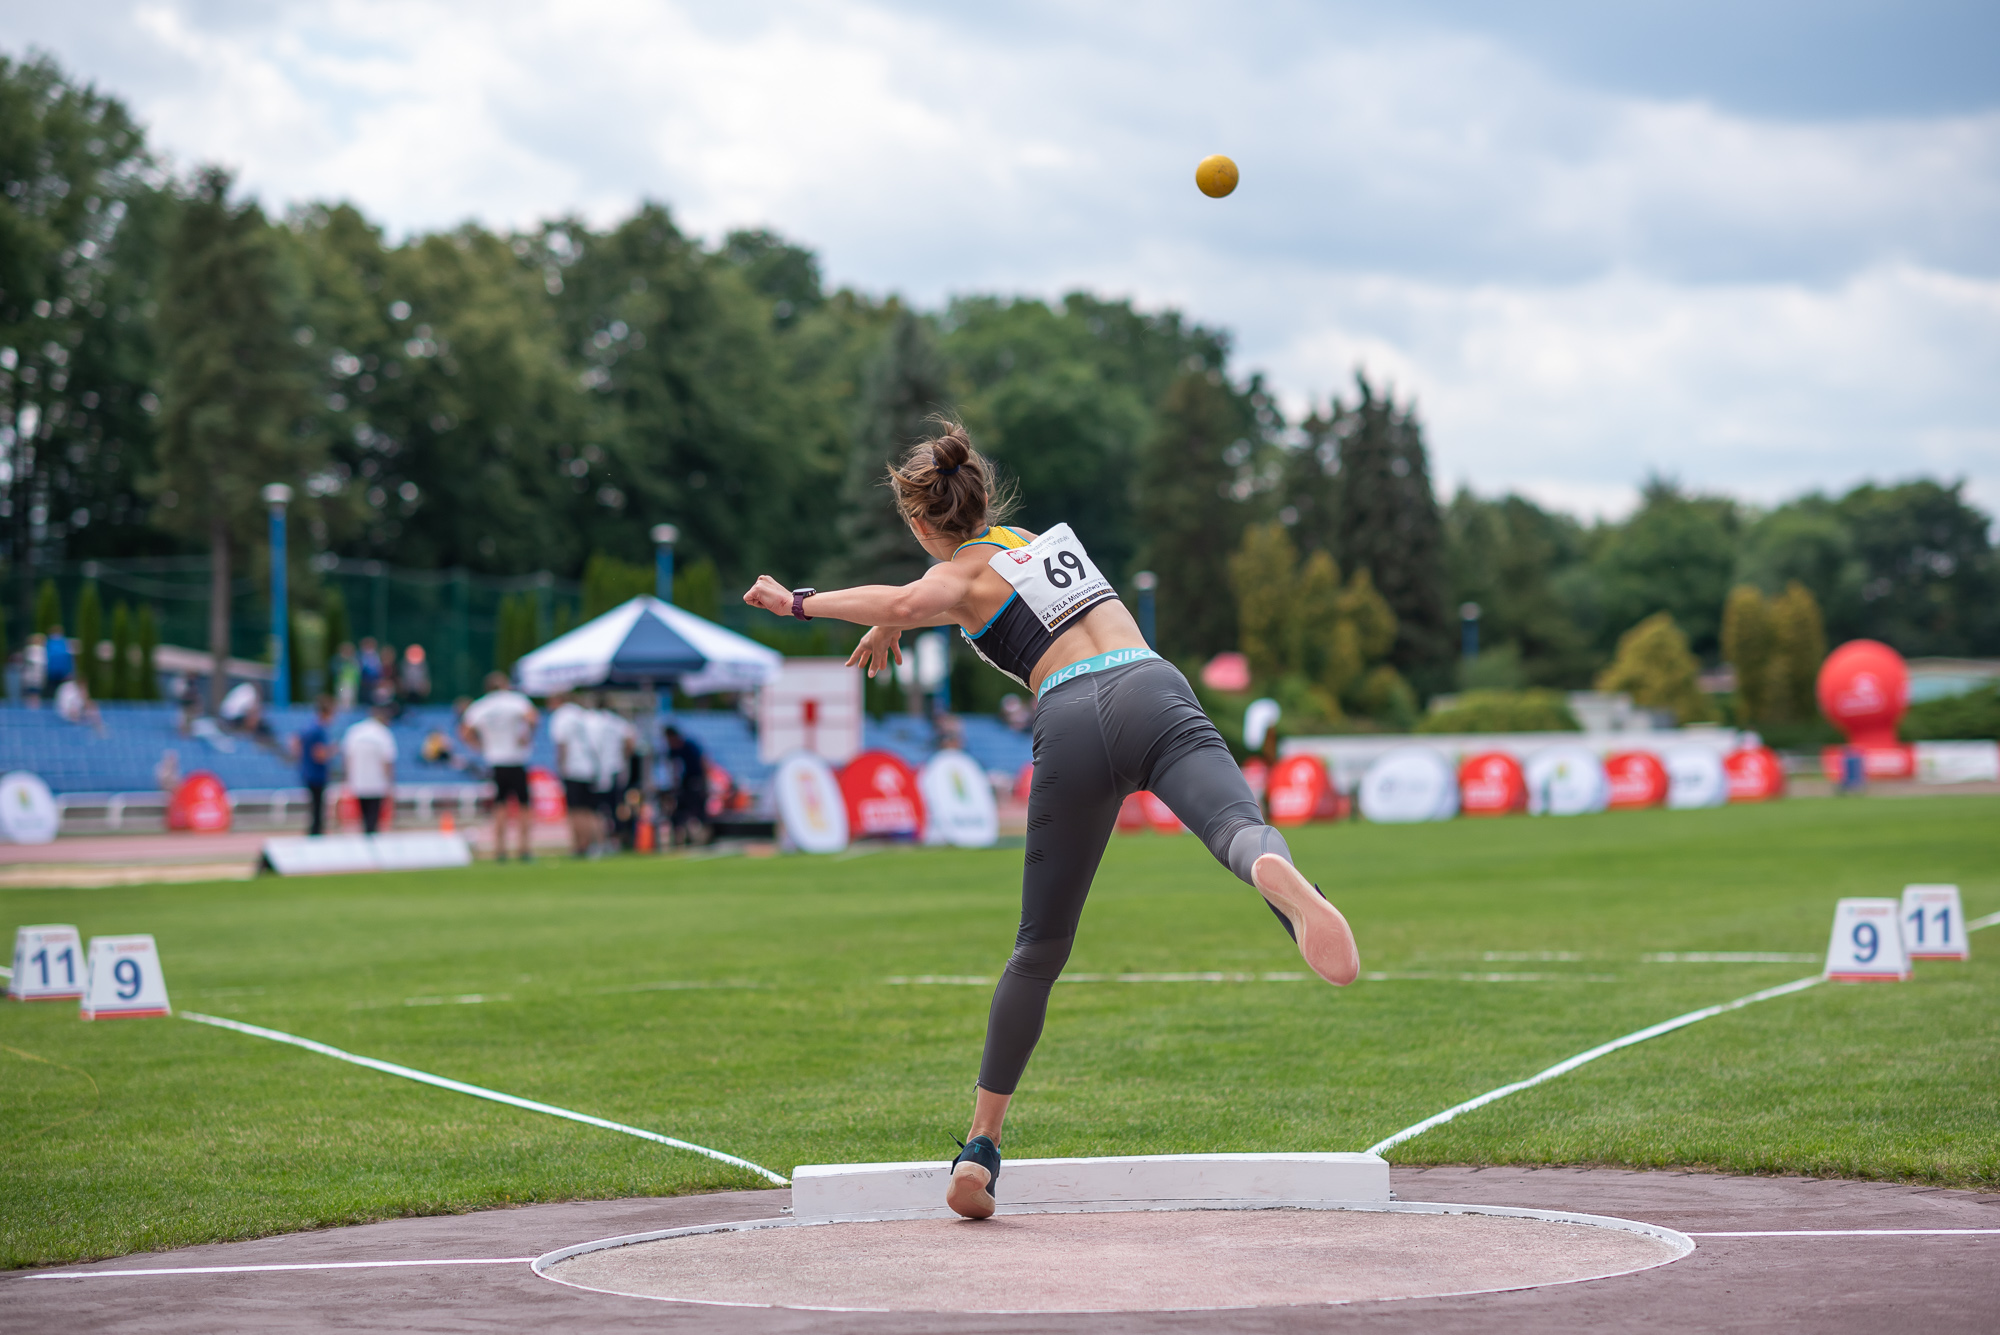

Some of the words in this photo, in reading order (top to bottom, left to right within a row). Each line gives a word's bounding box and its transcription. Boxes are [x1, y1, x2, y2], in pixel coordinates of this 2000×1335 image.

[1043, 550, 1087, 589] 69
[1052, 600, 1069, 614] PZLA
[1067, 583, 1100, 603] Mistrzostwa
[1852, 921, 1879, 963] 9
[1907, 906, 1950, 943] 11
[31, 946, 75, 985] 11
[114, 958, 142, 1000] 9
